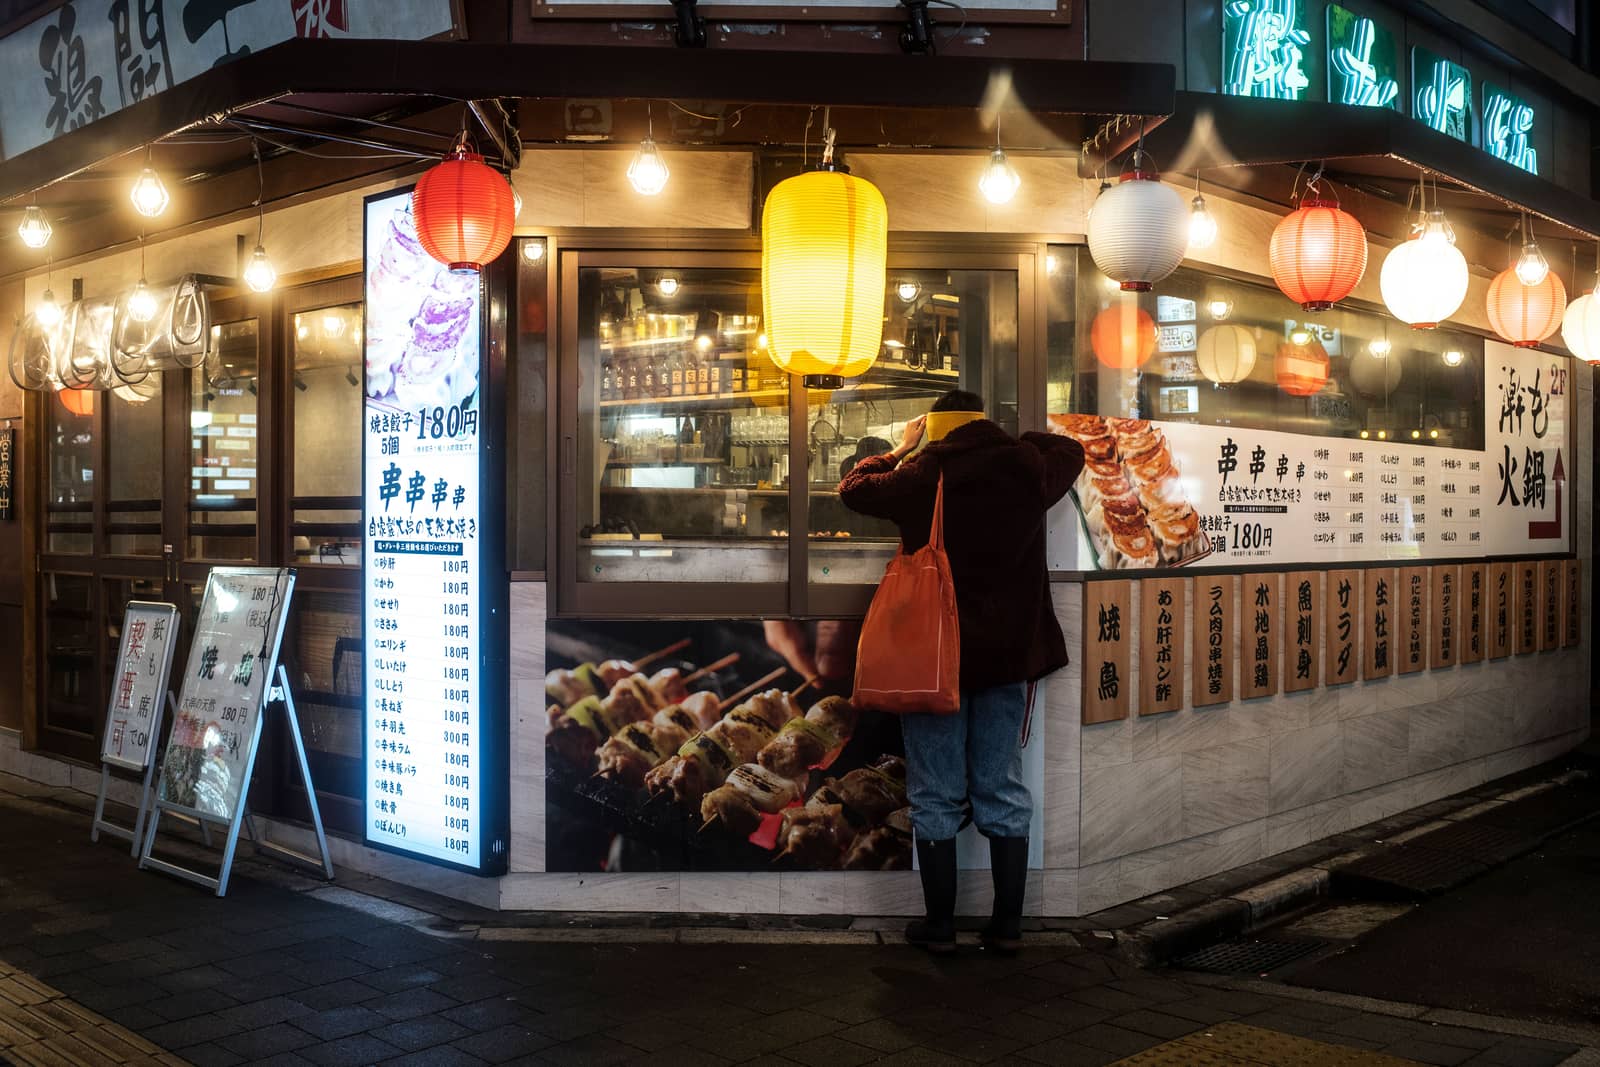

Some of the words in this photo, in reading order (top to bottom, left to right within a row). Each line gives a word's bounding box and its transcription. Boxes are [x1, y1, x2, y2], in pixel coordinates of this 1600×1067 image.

[1550, 364, 1567, 395] 2F
[370, 412, 414, 434] 焼き餃子
[417, 405, 478, 440] 180円
[381, 435, 400, 455] 5個
[1218, 438, 1306, 484] 串串串串
[379, 462, 466, 514] 串串串串
[1497, 445, 1546, 510] 火鍋
[1200, 515, 1232, 532] 焼き餃子
[1232, 522, 1273, 550] 180円
[1210, 534, 1226, 553] 5個
[379, 558, 396, 570] 砂肝
[443, 560, 469, 574] 180円
[379, 578, 394, 590] かわ
[442, 582, 469, 595] 180円
[380, 598, 400, 610] せせり
[443, 603, 469, 617] 180円
[380, 618, 398, 631] ささみ
[444, 625, 469, 639] 180円
[1297, 580, 1312, 680] 魚刺身
[1338, 578, 1352, 677] サラダ
[1374, 578, 1388, 670] 生牡蠣
[380, 639, 406, 652] エリンギ
[444, 646, 469, 660] 180円
[1098, 603, 1120, 700] 焼鳥
[1155, 589, 1172, 702] あん肝ポン酢
[1208, 585, 1223, 695] ラム肉の串焼き
[380, 659, 406, 673] しいたけ
[444, 668, 469, 682] 180円
[380, 678, 404, 694] ししとう
[444, 688, 469, 704] 180円
[220, 706, 248, 724] 180円
[380, 698, 404, 714] 長ねぎ
[444, 710, 470, 725] 180円
[380, 718, 406, 736] 手羽先
[444, 731, 470, 747] 300円
[380, 739, 411, 756] 辛味ラム
[445, 752, 470, 768] 180円
[380, 759, 416, 776] 辛味豚バラ
[444, 774, 470, 790] 180円
[380, 780, 403, 796] 焼き鳥
[444, 795, 470, 811] 180円
[380, 799, 397, 816] 軟骨
[445, 816, 470, 833] 180円
[380, 819, 406, 838] ぼんじり
[445, 836, 470, 854] 180円
